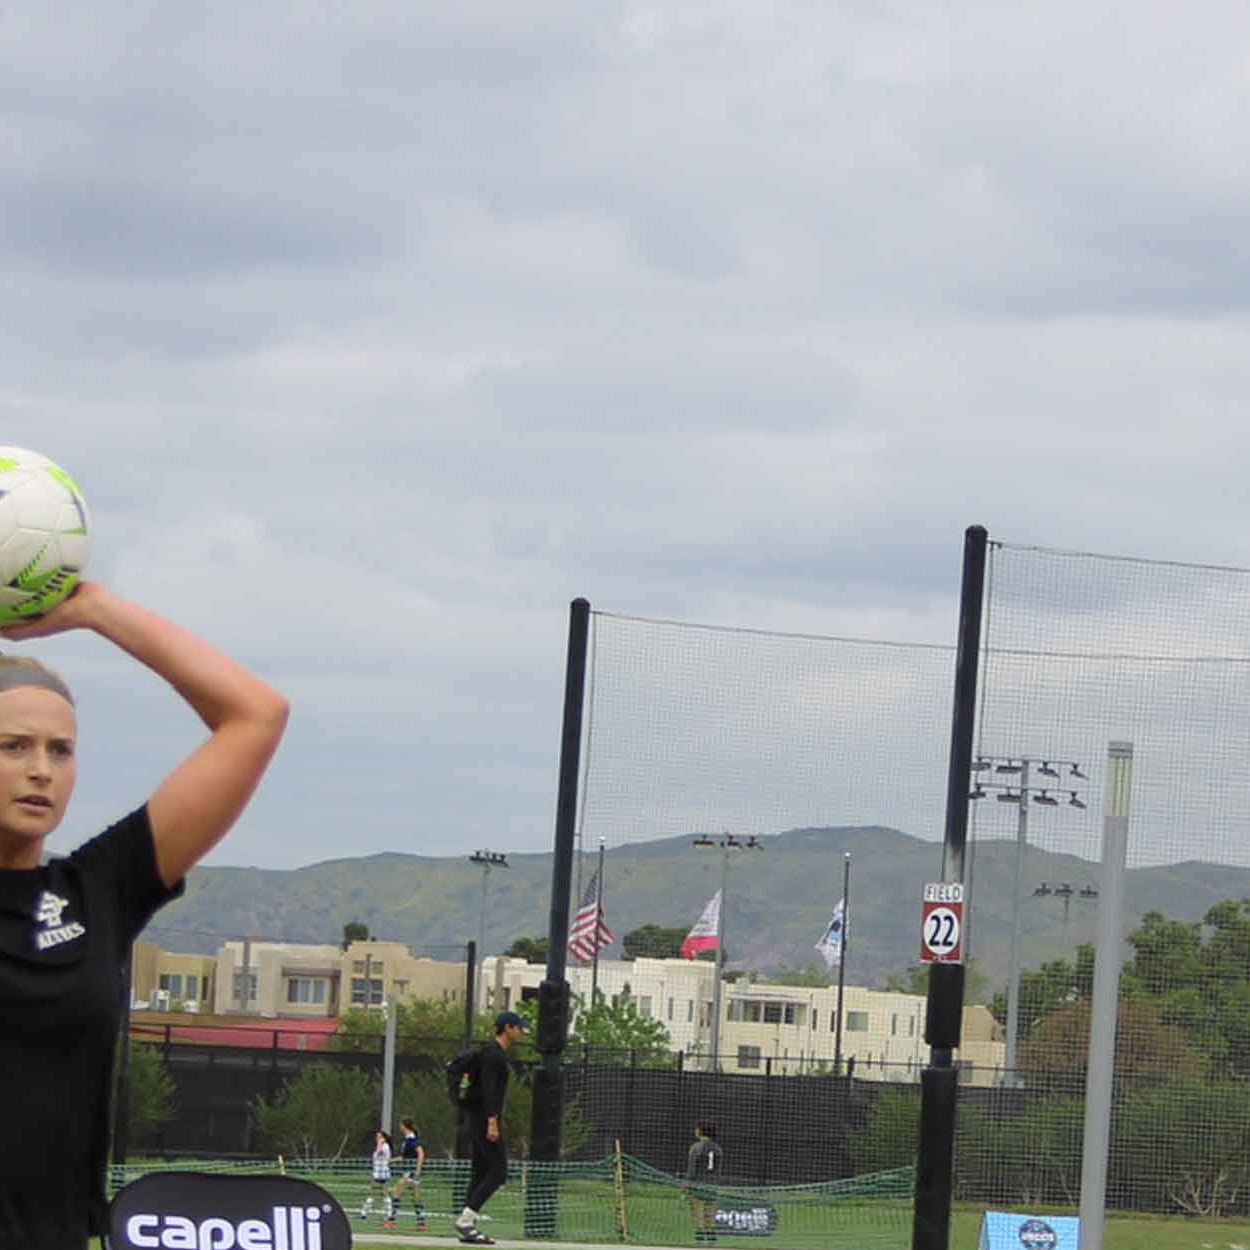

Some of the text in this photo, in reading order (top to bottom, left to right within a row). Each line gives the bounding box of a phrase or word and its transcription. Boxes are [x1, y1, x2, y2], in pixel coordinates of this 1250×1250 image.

[925, 885, 961, 900] FIELD
[928, 914, 955, 947] 22
[707, 1150, 715, 1171] 1
